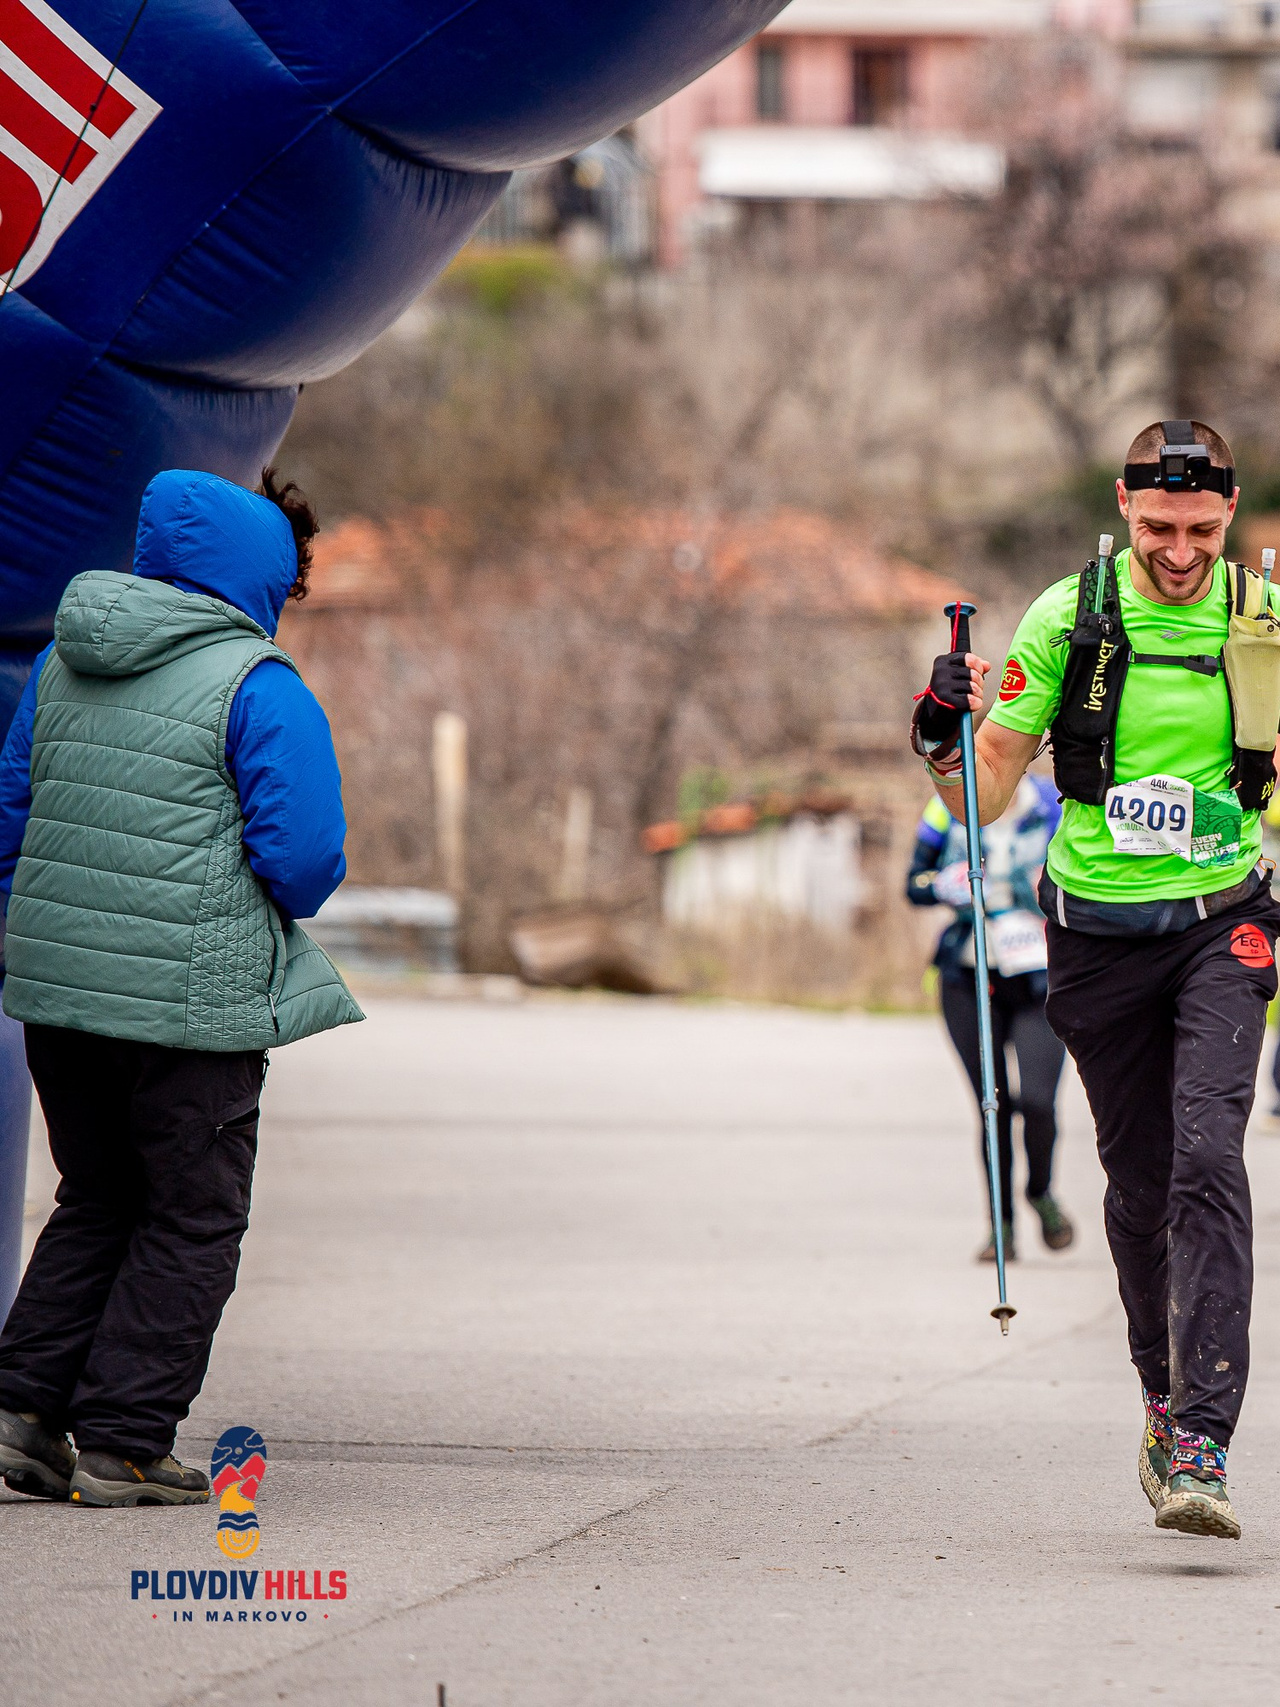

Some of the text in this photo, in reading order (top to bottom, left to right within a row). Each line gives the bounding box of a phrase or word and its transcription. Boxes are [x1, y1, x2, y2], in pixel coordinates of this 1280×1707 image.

[1150, 778, 1168, 790] 44K
[1108, 795, 1186, 832] 4209
[1240, 936, 1266, 950] EGT
